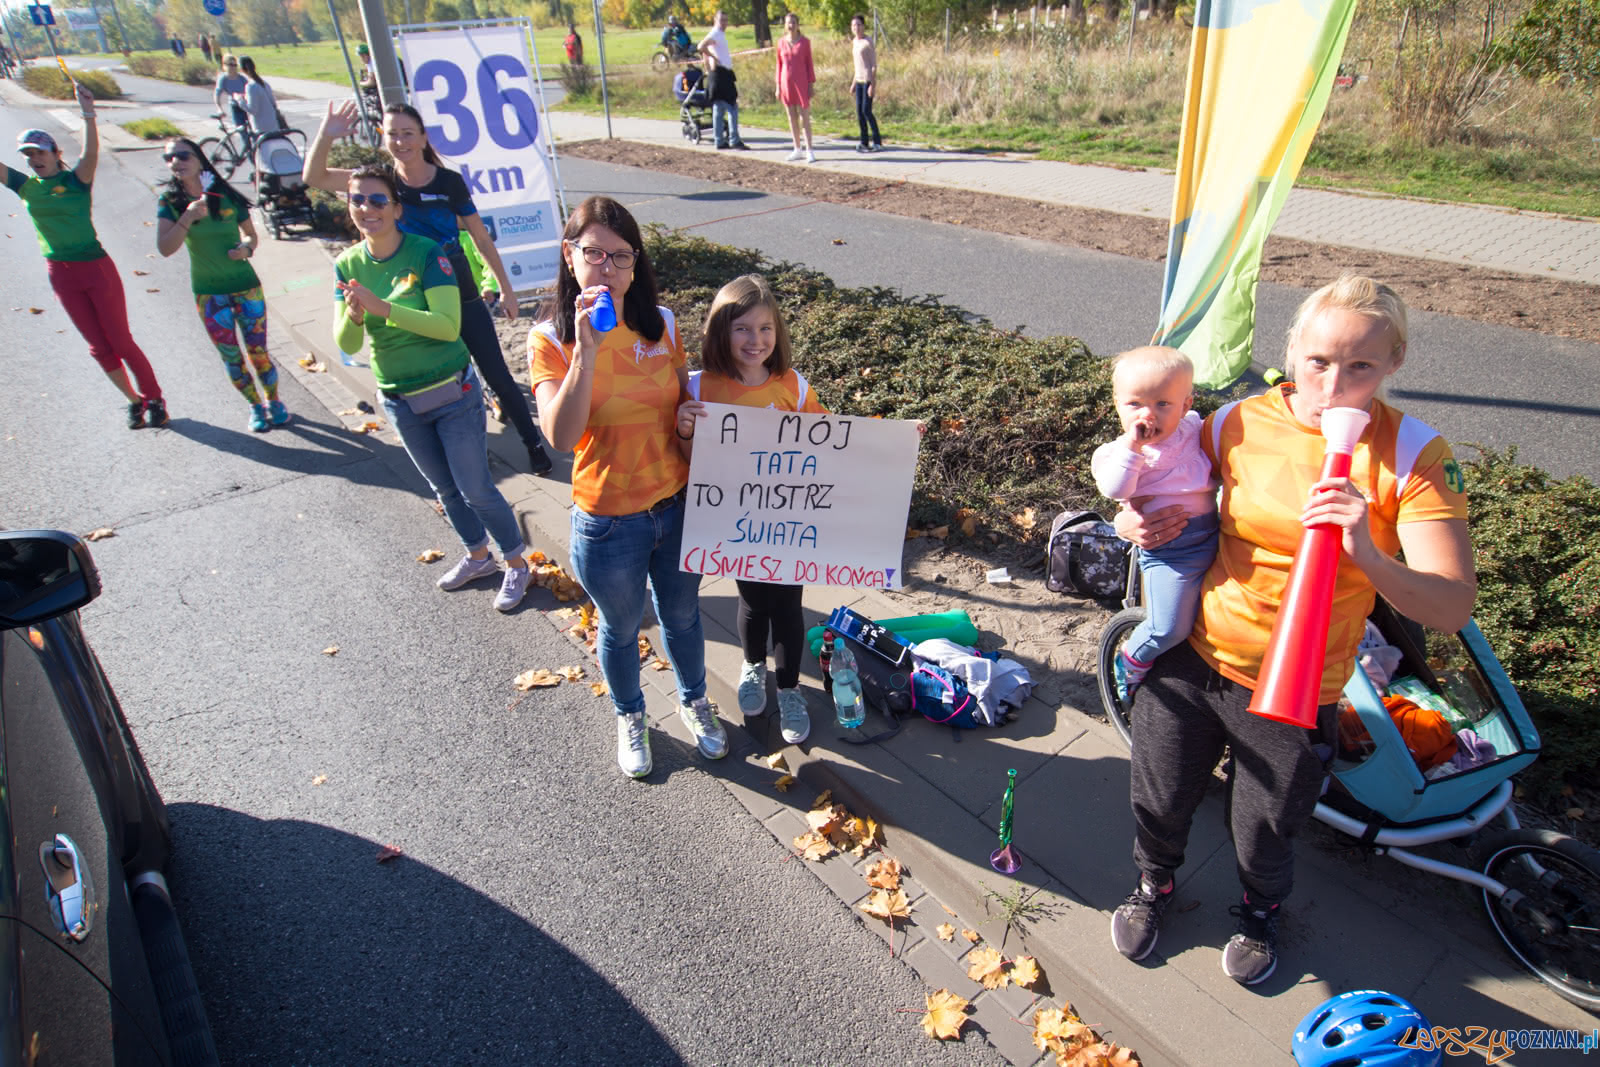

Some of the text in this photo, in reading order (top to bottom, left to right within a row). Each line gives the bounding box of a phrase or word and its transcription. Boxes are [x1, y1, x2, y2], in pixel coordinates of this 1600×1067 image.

[413, 54, 538, 157] 36
[461, 164, 525, 195] km
[720, 412, 852, 450] A MÓJ
[750, 450, 817, 476] TATA
[693, 482, 835, 510] TO MISTRZ
[727, 511, 817, 548] ŚWIATA
[684, 542, 897, 587] CIŚNIESZ DO KOŃCA!
